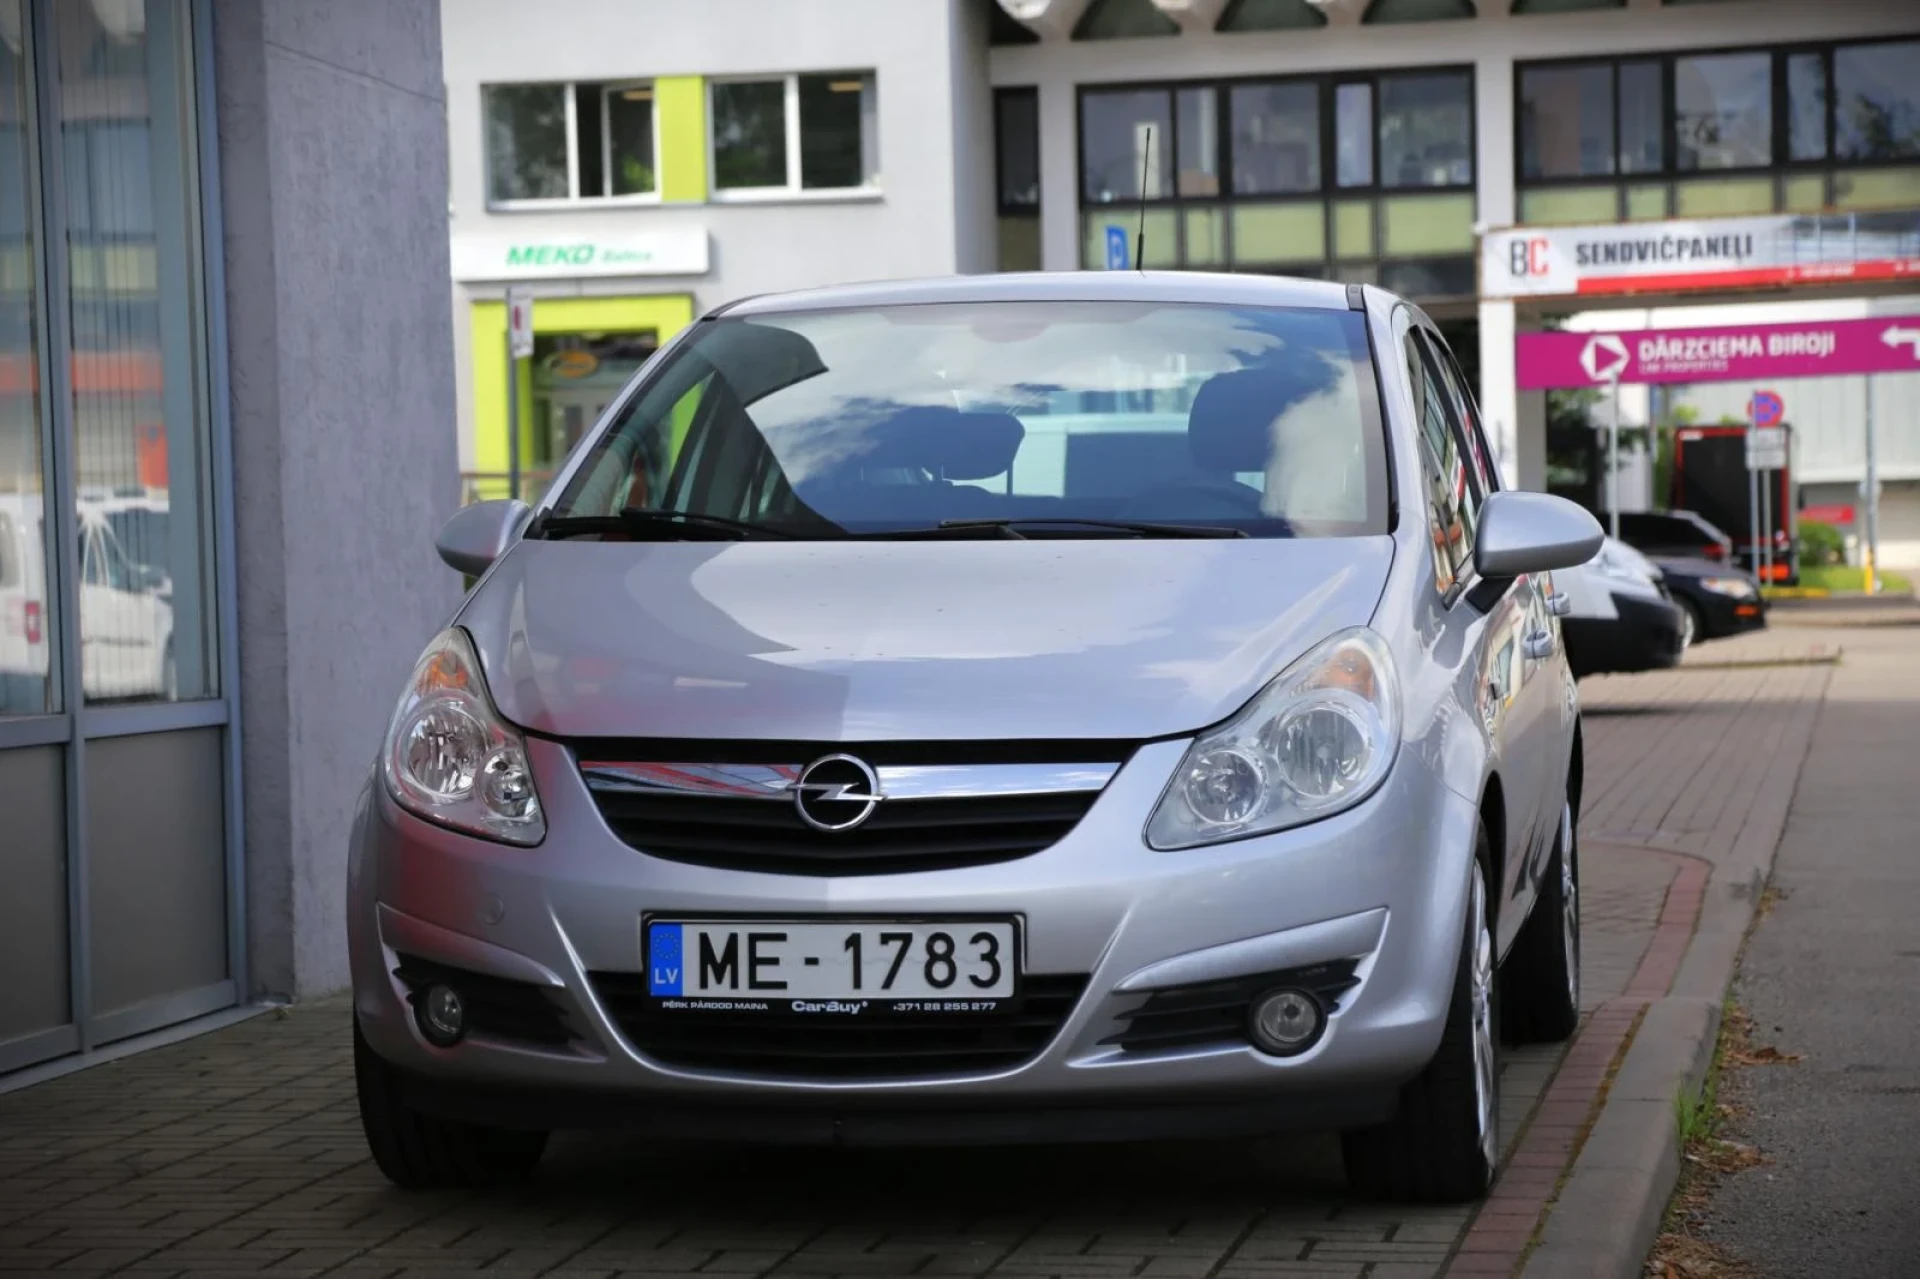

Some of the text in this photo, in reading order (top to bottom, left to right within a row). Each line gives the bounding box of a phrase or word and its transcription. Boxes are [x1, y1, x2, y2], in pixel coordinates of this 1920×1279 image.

[506, 243, 596, 266] MEKO
[1510, 235, 1753, 277] BC SENDVIČPANEĻI
[1638, 331, 1835, 362] DĀRZCIEMA BIROJI
[699, 931, 1001, 990] ME-1783
[654, 968, 679, 985] LV
[662, 1000, 768, 1010] PĒRK PĀRDOD MAINA
